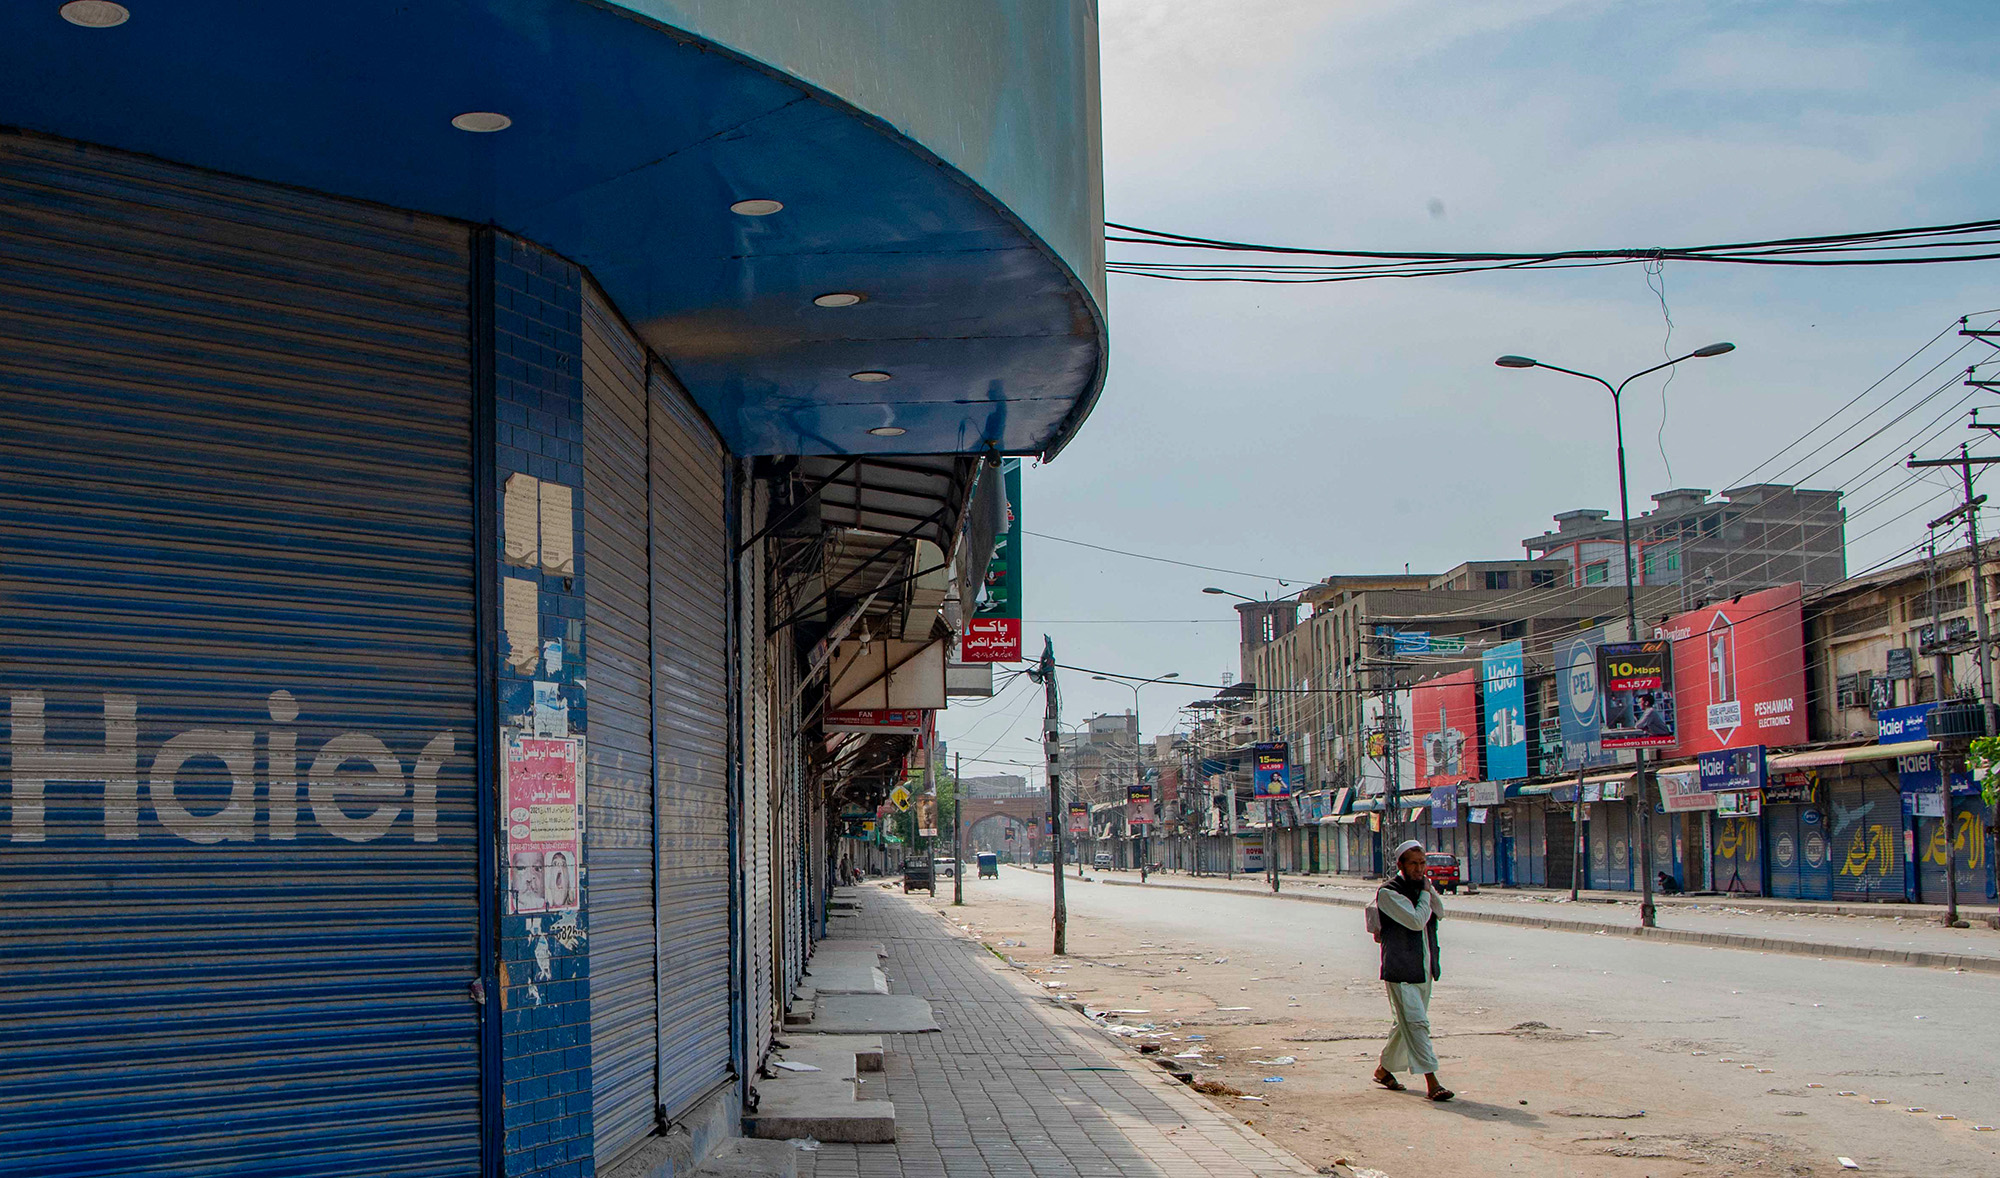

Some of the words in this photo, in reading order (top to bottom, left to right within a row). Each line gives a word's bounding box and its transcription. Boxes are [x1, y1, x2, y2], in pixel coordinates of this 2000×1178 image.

[973, 620, 1007, 636] پاک
[967, 637, 1016, 648] الیکٹرانکس
[1488, 660, 1517, 693] Haier
[1571, 671, 1594, 695] PEL
[1618, 679, 1652, 689] Rs.1,577
[1754, 698, 1794, 717] PESHAWAR
[1758, 715, 1791, 729] ELECTRONICS
[1879, 718, 1904, 737] Haier
[9, 690, 455, 843] Haier
[1700, 757, 1725, 777] Haier
